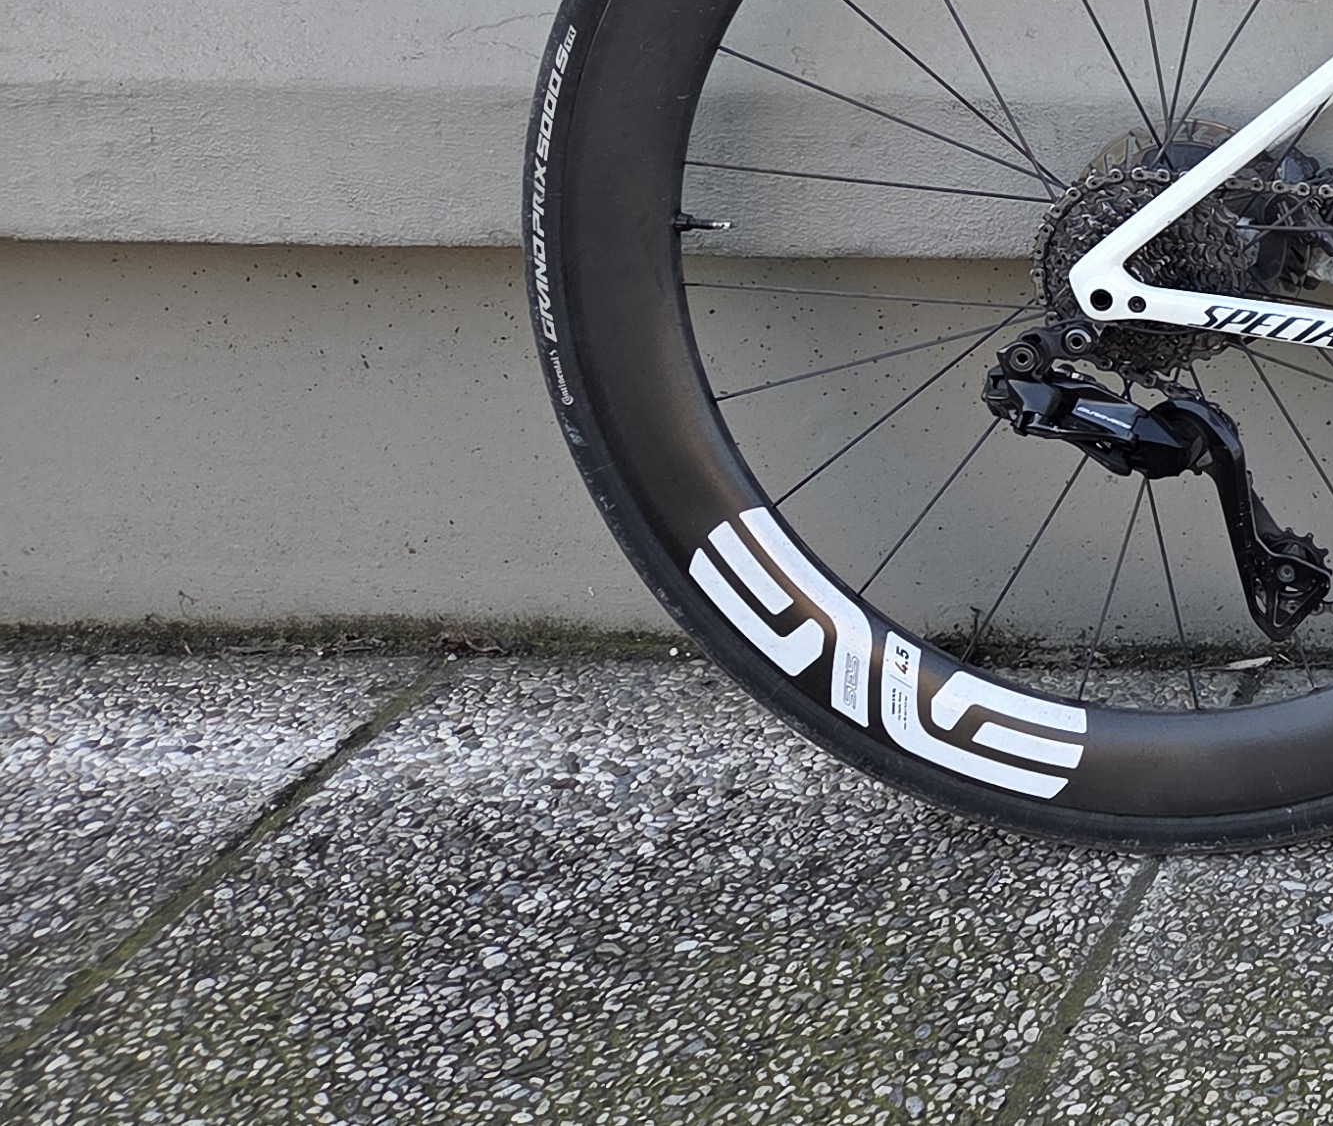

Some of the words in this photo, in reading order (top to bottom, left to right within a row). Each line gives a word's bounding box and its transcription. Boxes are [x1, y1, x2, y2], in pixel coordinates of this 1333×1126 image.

[536, 68, 562, 161] 5000
[532, 158, 547, 237] PRIX
[532, 235, 557, 342] GRAND
[895, 645, 910, 675] 4.5
